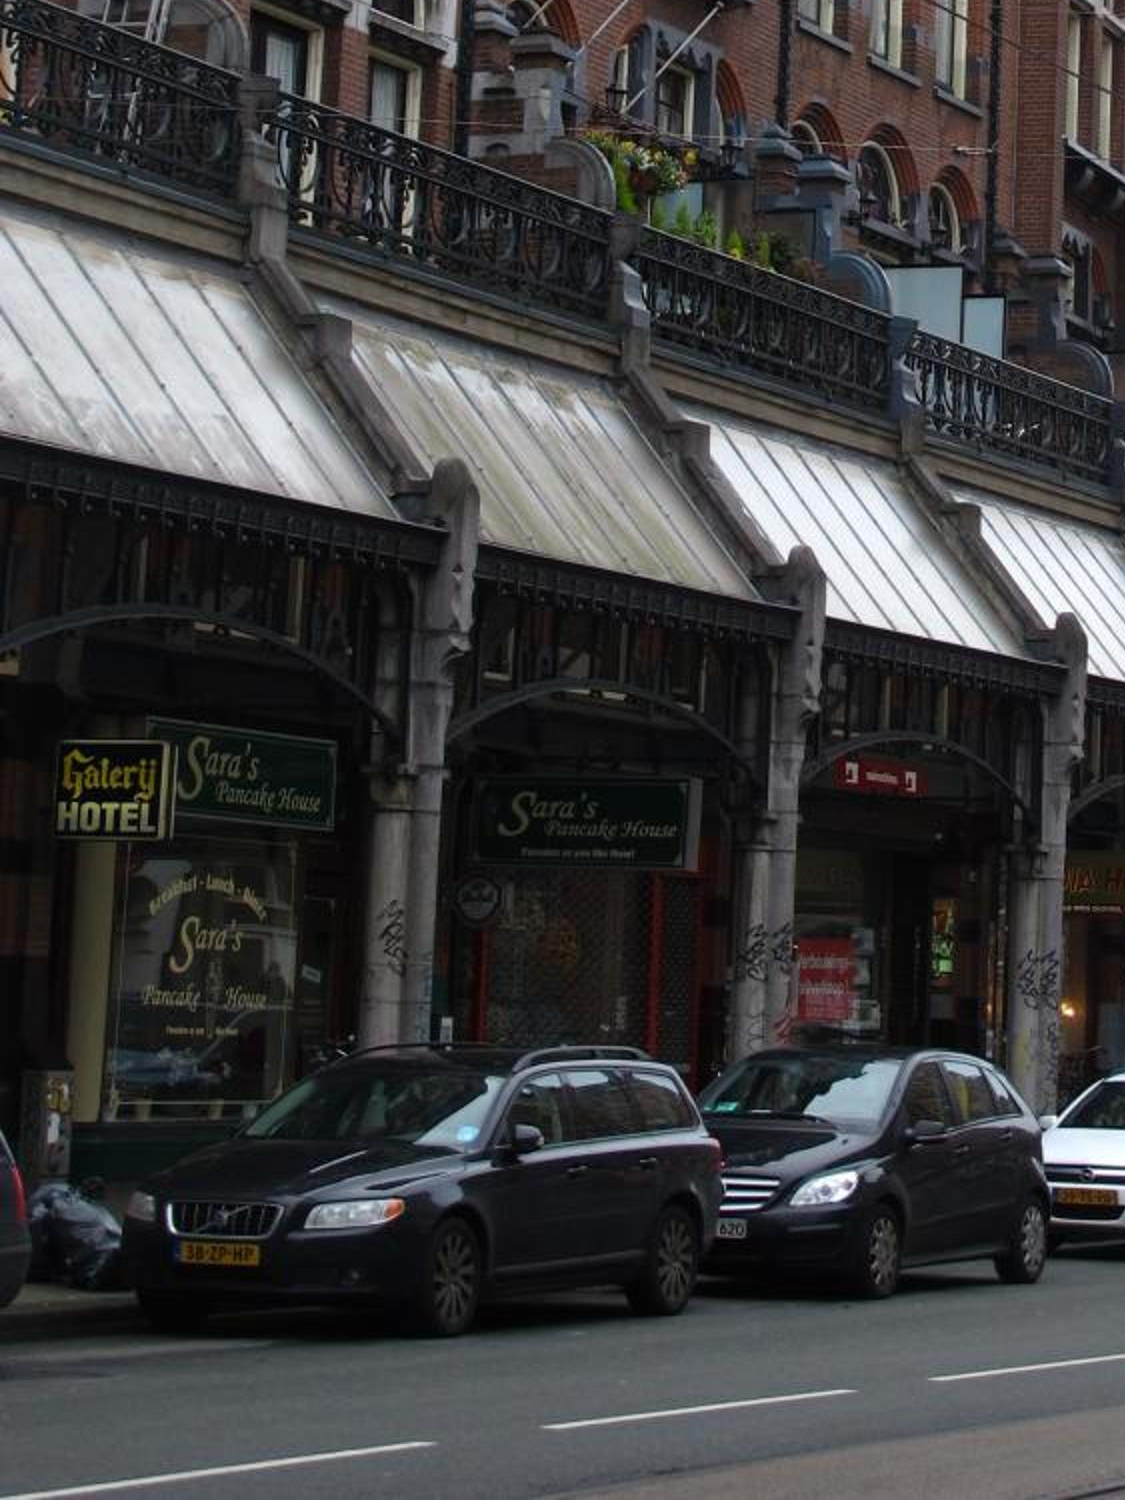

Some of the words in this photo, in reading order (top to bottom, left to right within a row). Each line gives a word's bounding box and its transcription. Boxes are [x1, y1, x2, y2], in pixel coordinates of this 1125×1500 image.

[177, 735, 261, 801] Sara's
[215, 781, 276, 814] Pancake
[277, 786, 321, 814] House
[496, 790, 600, 837] Sara's
[56, 801, 157, 833] HOTEL
[543, 819, 617, 841] Pancake
[619, 819, 678, 837] House
[168, 915, 243, 974] Sara's
[143, 983, 201, 1012] Pancake
[224, 985, 268, 1011] House
